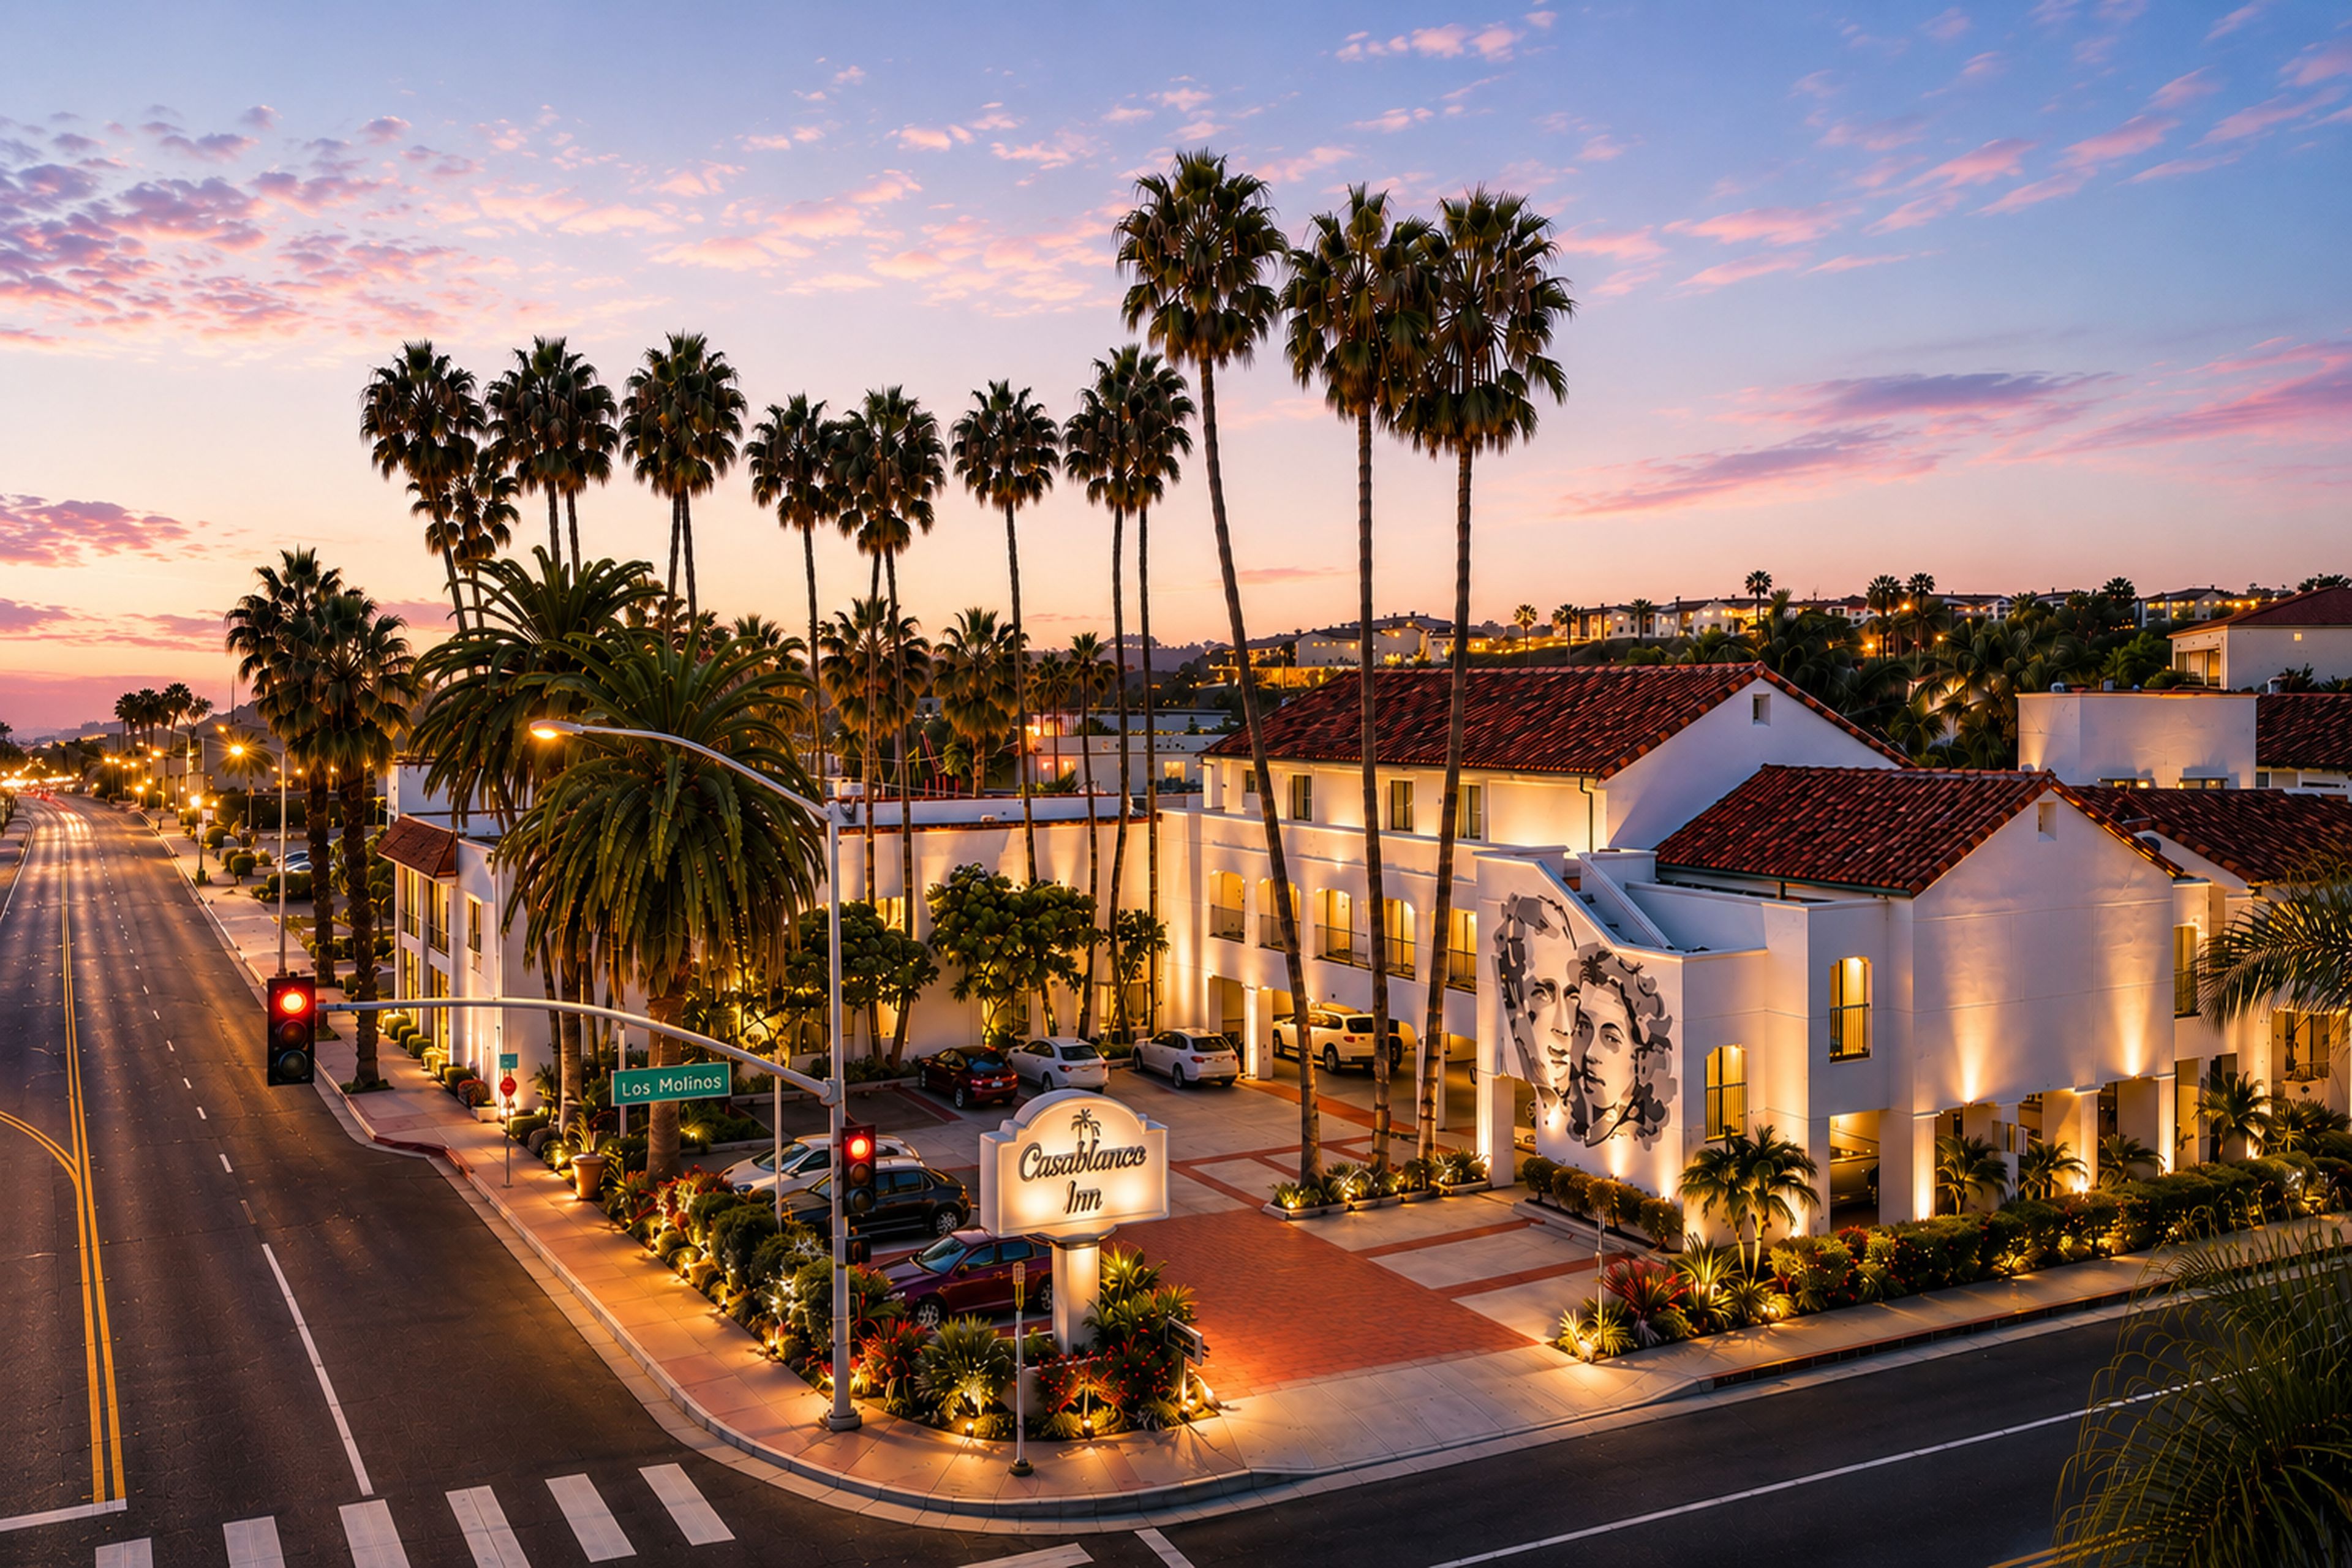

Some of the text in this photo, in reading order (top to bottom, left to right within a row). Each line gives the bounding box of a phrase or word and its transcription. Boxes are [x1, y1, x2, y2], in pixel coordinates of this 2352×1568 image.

[622, 1075, 722, 1097] Los Molinos
[1065, 1180, 1102, 1215] Inn
